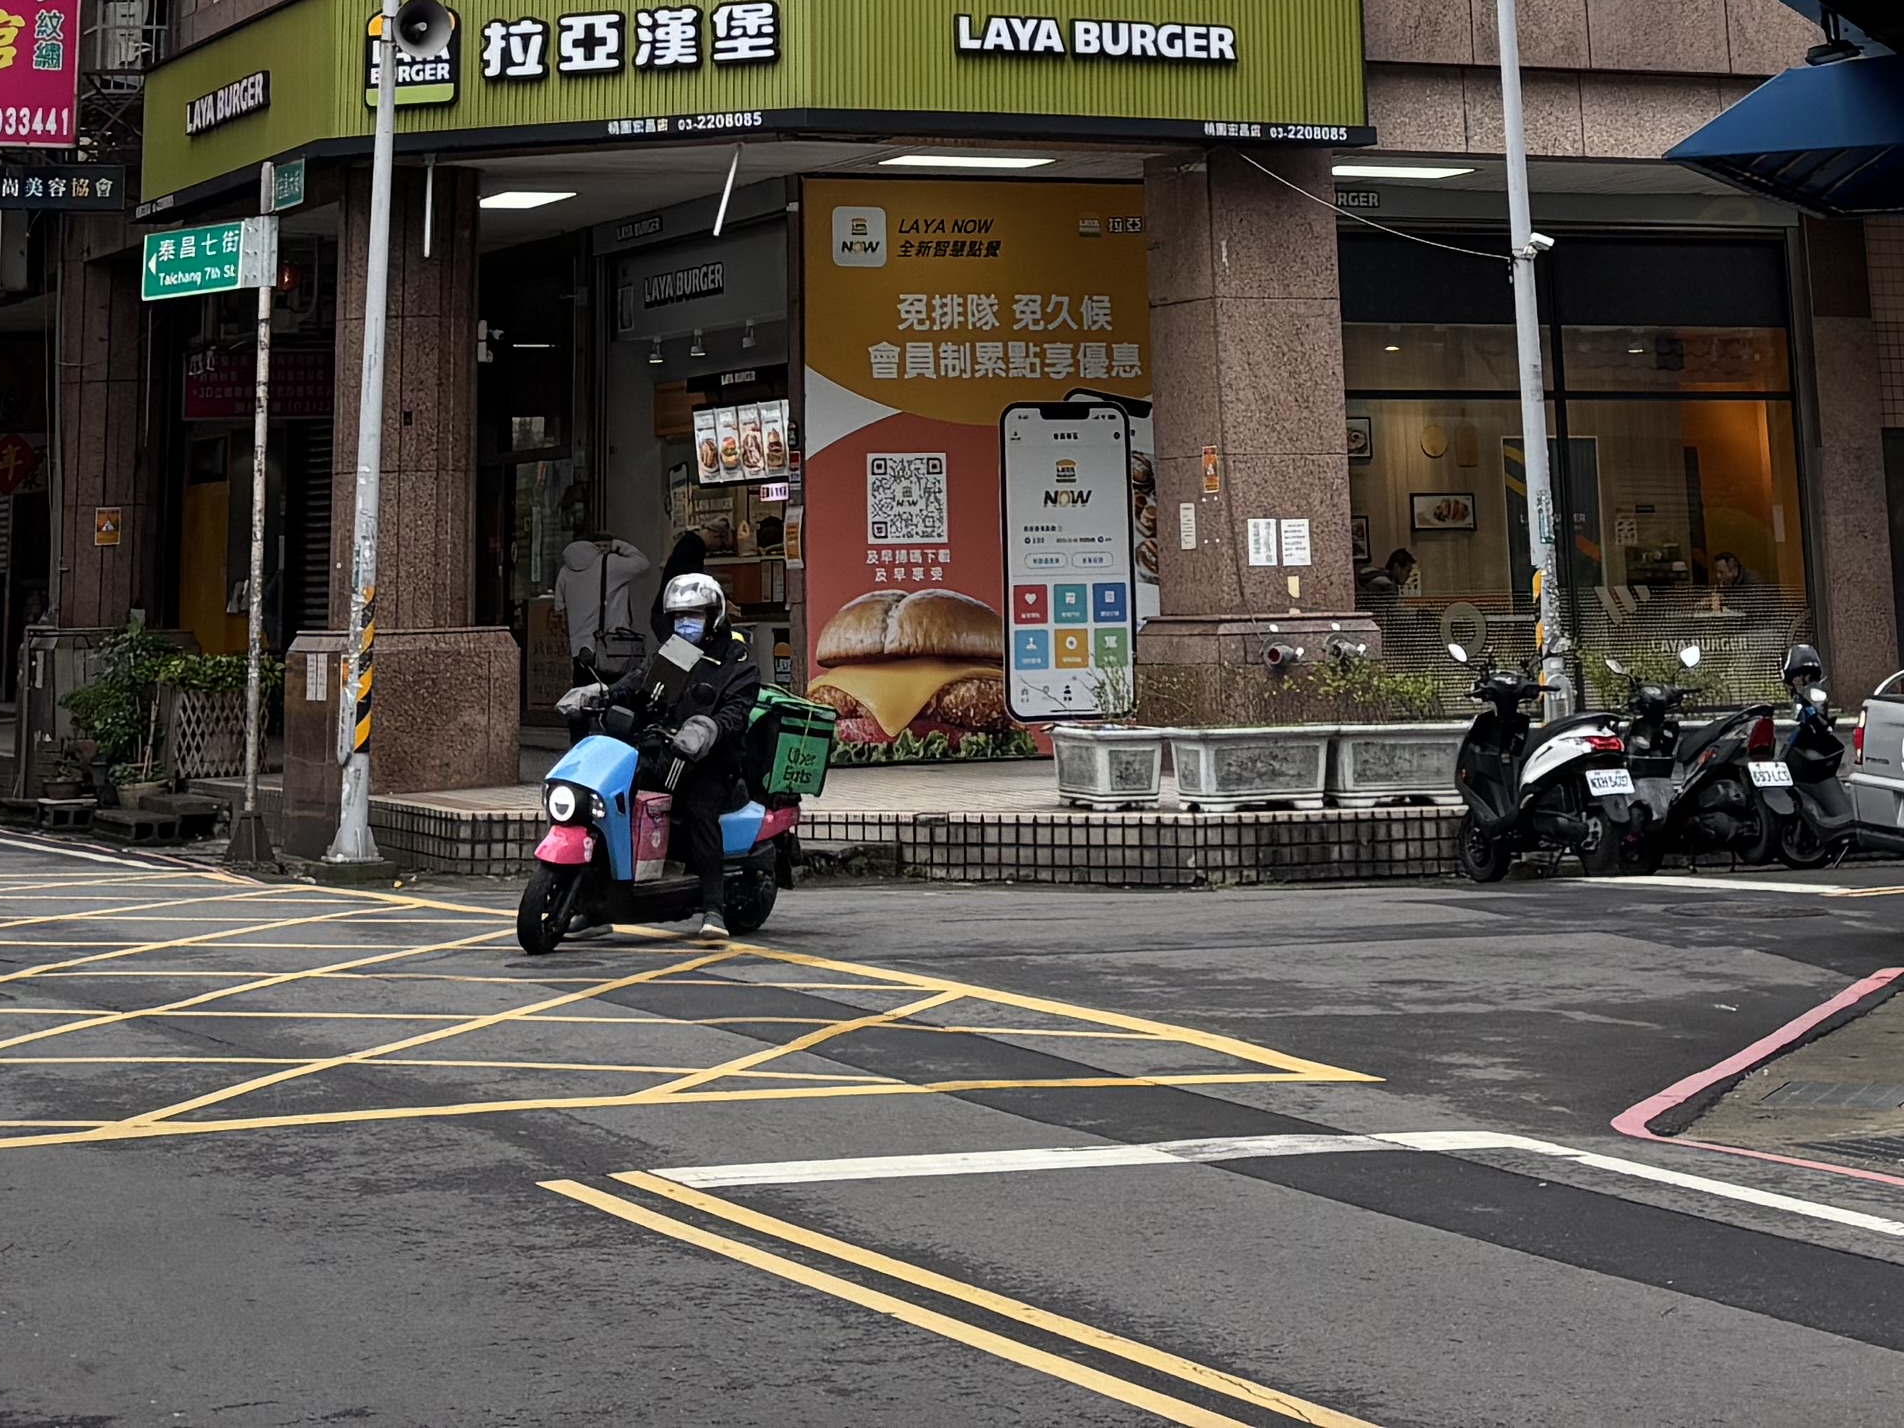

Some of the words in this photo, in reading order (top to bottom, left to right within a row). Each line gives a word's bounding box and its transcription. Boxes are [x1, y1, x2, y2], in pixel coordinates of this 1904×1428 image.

[483, 0, 777, 78] 拉亞漢堡
[958, 16, 1063, 55] LAYA
[1074, 22, 1235, 61] BURGER
[371, 62, 450, 85] BRGER
[186, 94, 216, 134] LAYA
[216, 72, 264, 120] BURGER
[678, 112, 762, 131] 03-2208085
[1270, 125, 1348, 141] 03-2208085
[1337, 192, 1379, 207] RGER
[898, 218, 946, 234] LAYA
[951, 218, 994, 234] NOW
[158, 231, 240, 261] 泰昌七街
[676, 263, 724, 295] BURGER
[897, 294, 1000, 331] 免排隊
[1012, 294, 1113, 331] 免久候
[868, 341, 1142, 380] 會員制累點享優惠
[787, 747, 817, 767] Uber
[782, 765, 813, 785] Eats
